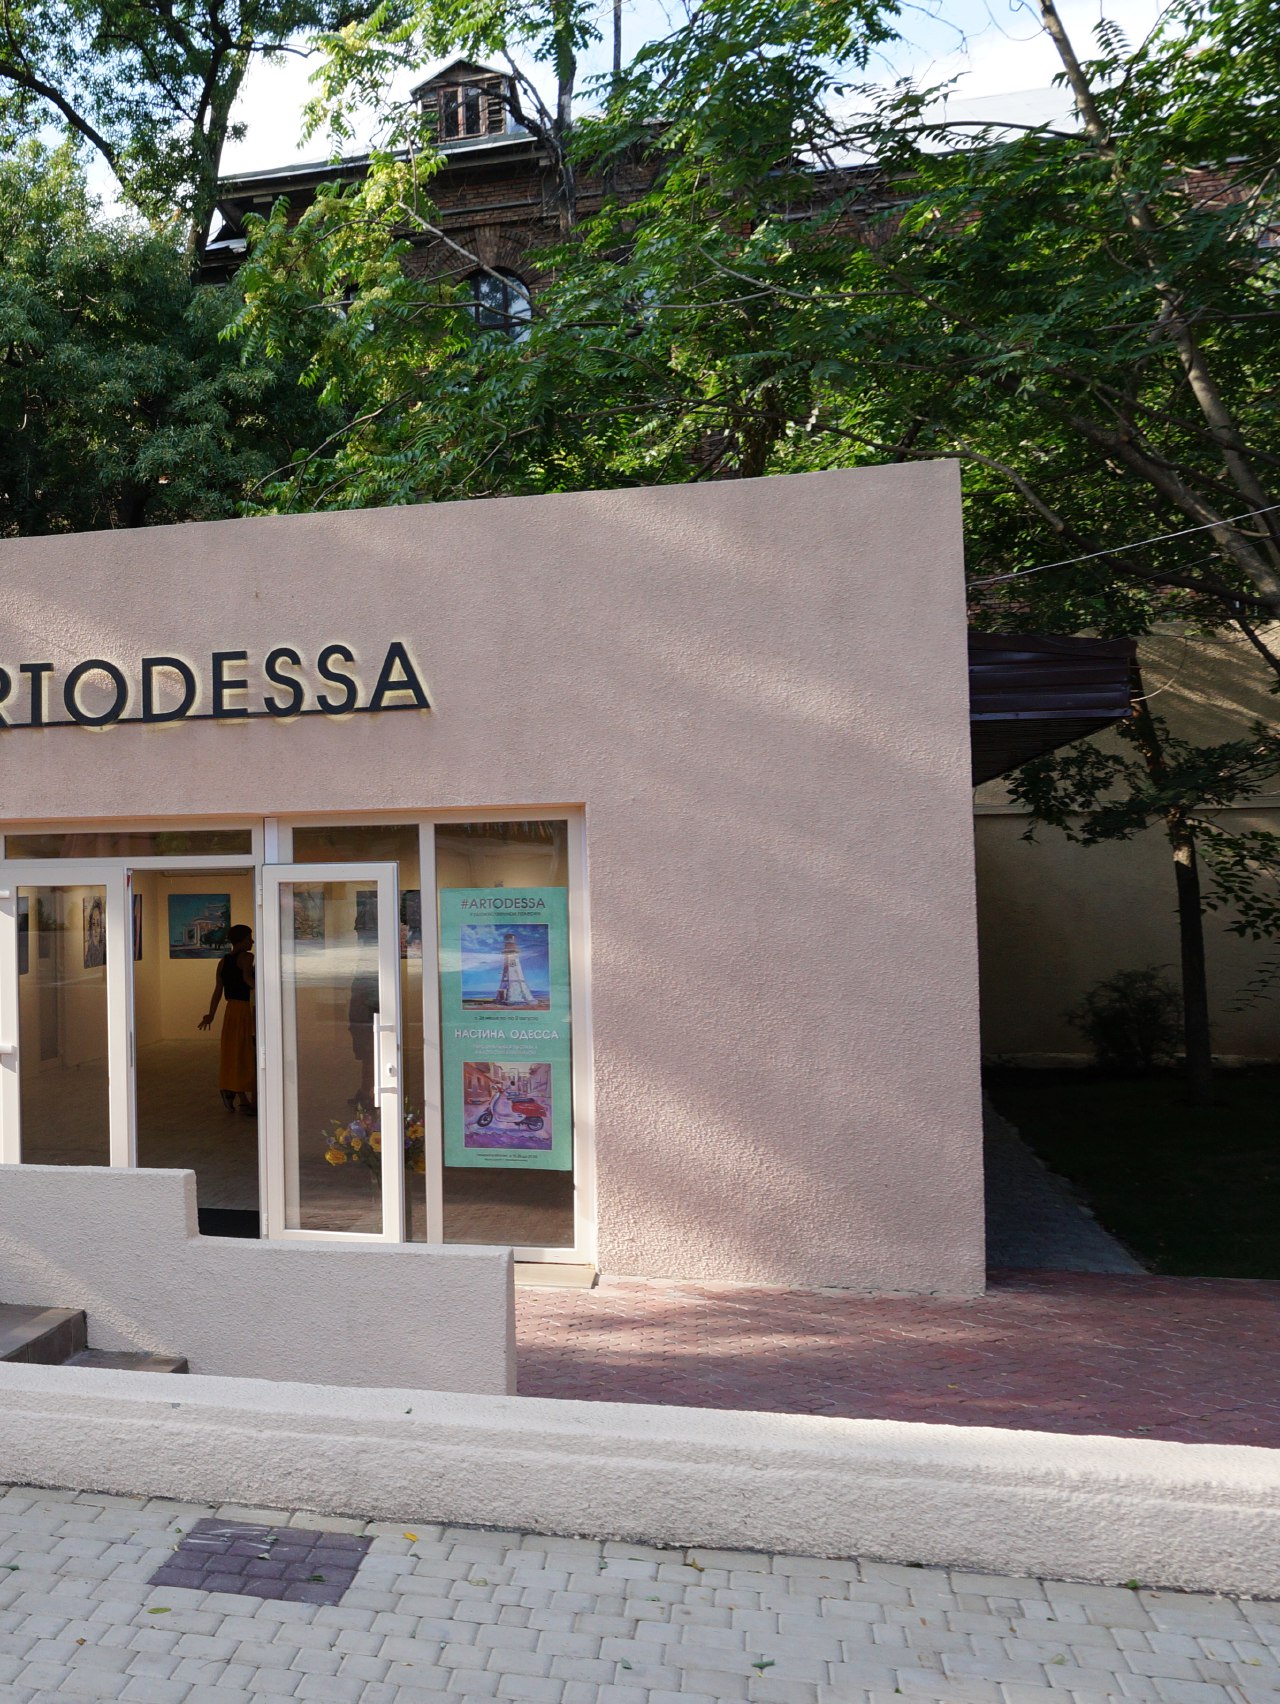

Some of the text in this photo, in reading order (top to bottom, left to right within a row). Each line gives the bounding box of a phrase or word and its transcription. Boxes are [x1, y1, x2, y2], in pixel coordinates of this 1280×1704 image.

[460, 897, 546, 910] #ARTODESSA
[454, 1029, 559, 1040] НАСТИНА ОДЕССА
